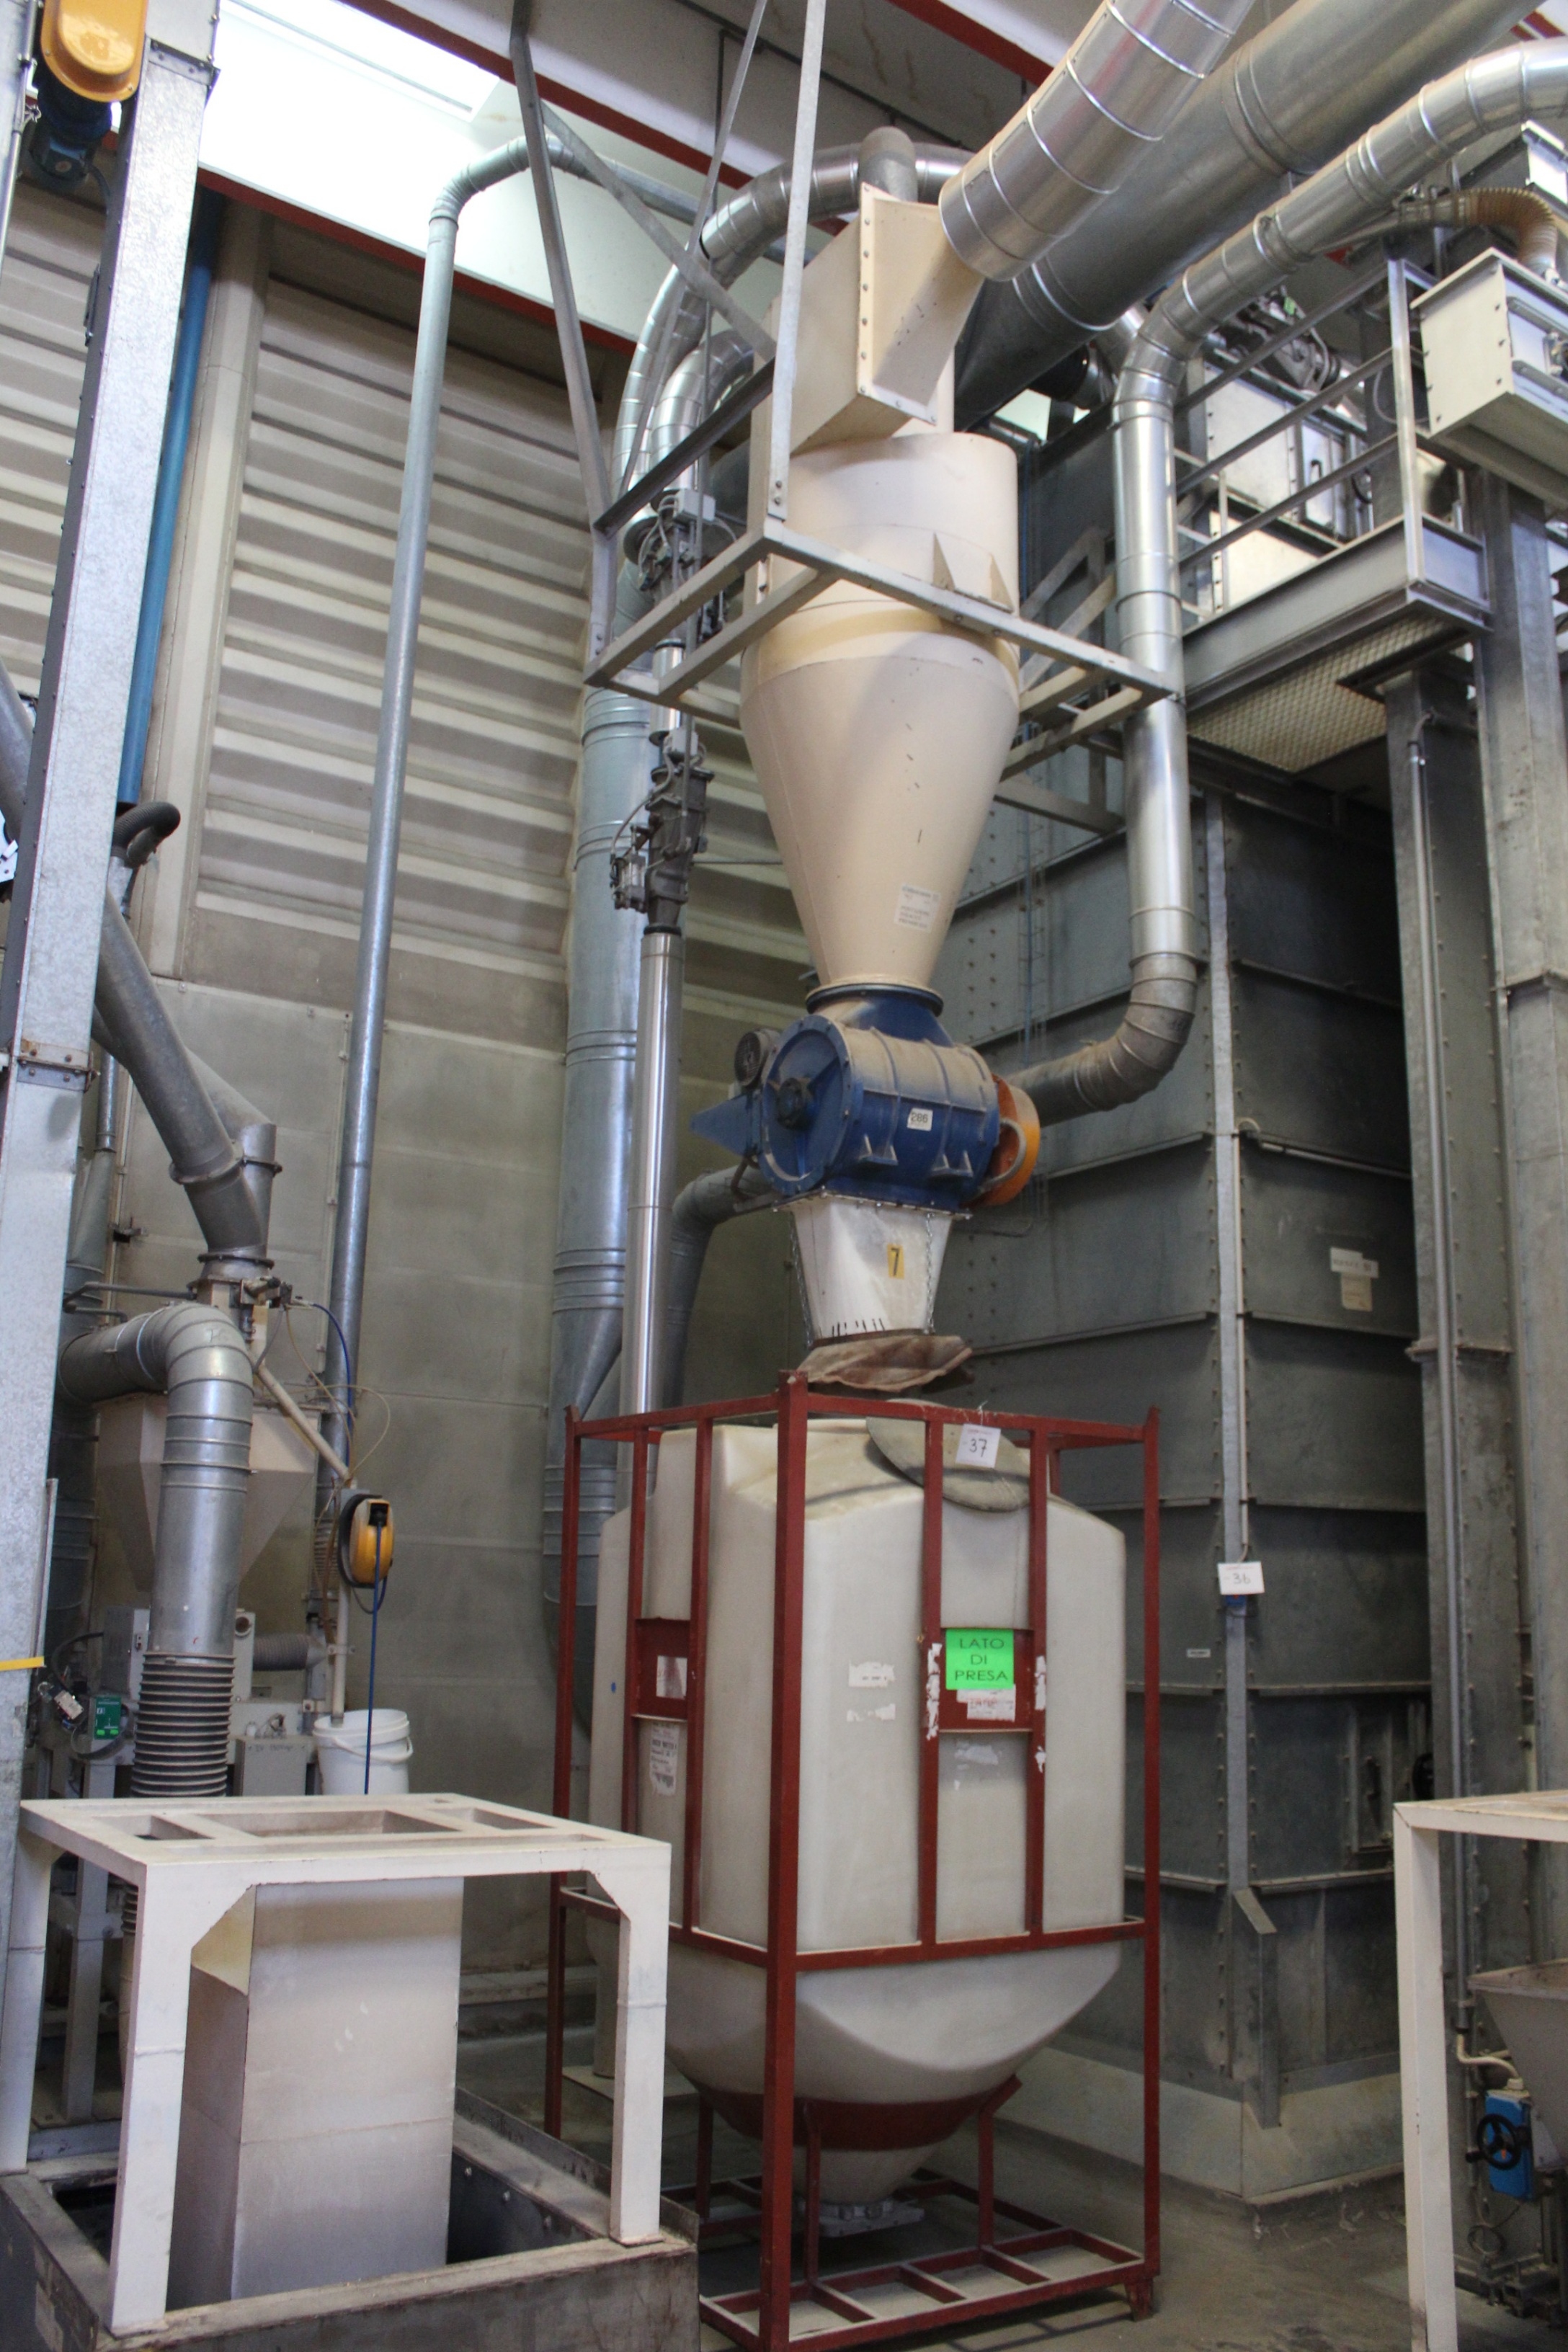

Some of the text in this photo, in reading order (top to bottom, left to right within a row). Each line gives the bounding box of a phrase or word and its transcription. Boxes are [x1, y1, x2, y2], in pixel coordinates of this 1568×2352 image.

[911, 1111, 929, 1123] 286
[891, 1247, 901, 1277] 7
[968, 1438, 988, 1458] 37
[958, 1637, 1005, 1650] LATO
[970, 1653, 988, 1665] DI
[954, 1669, 1008, 1682] PRESA
